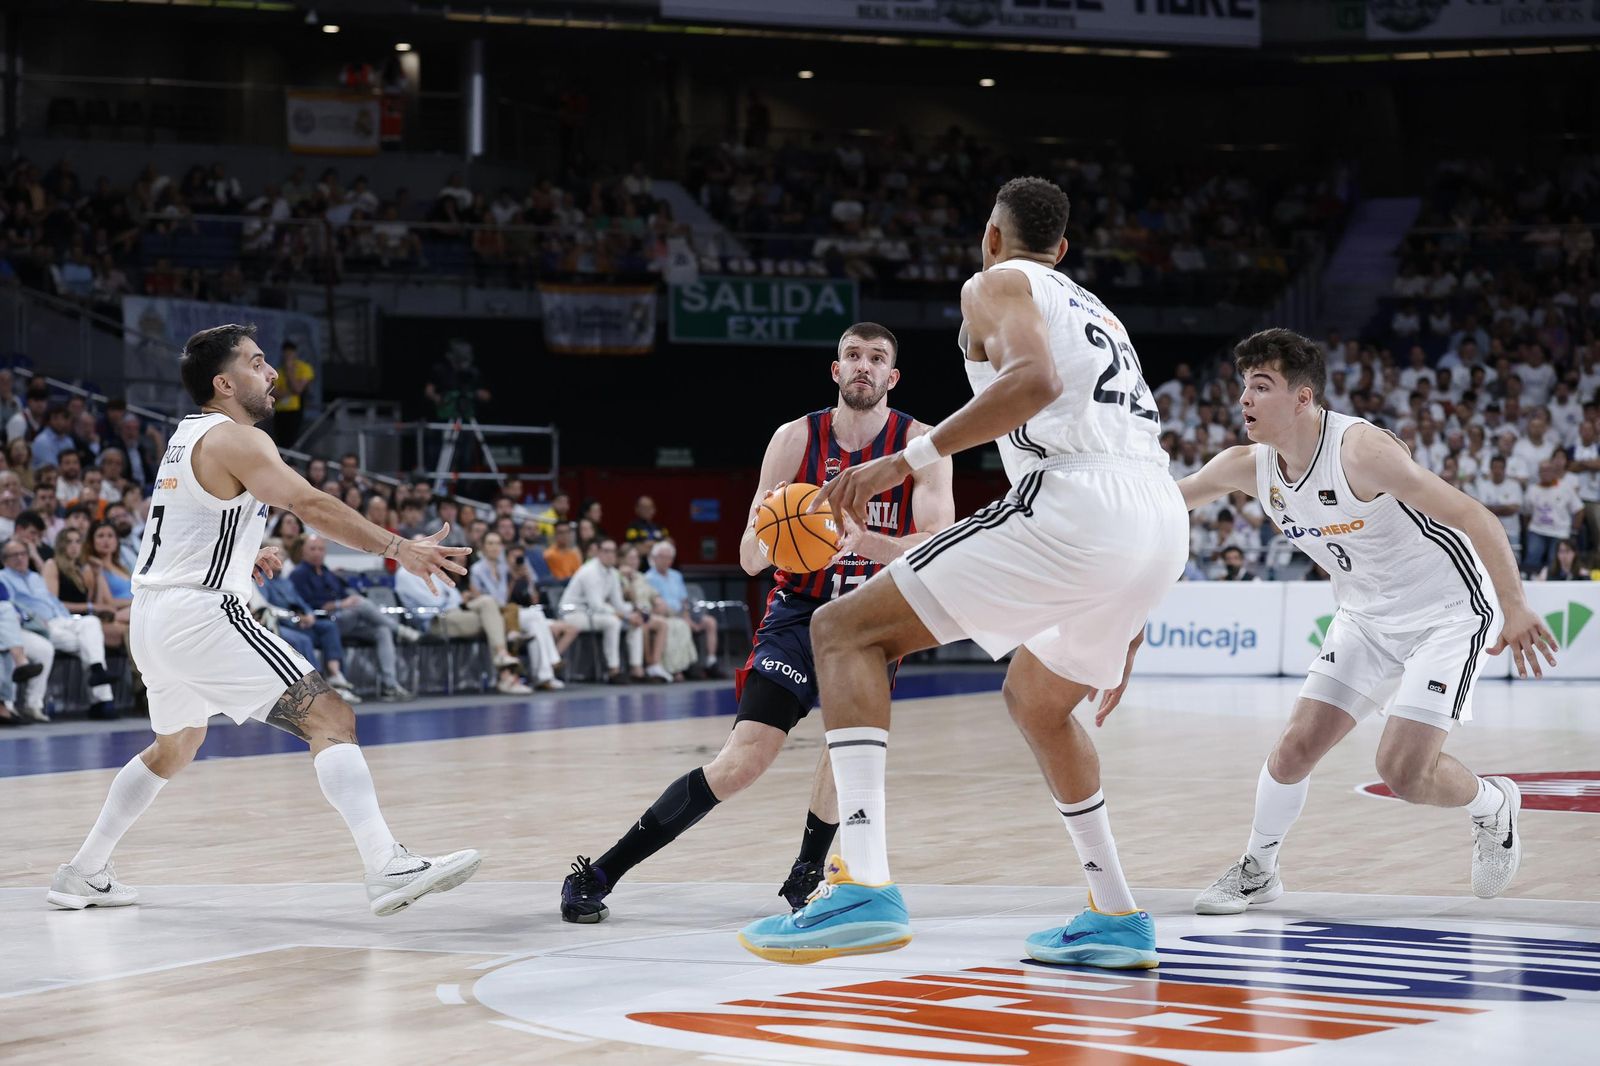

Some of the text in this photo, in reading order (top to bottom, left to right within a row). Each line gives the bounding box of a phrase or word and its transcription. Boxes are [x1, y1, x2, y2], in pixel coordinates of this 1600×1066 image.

[680, 281, 845, 317] SALIDA
[726, 315, 800, 341] EXIT
[1326, 542, 1352, 573] 9
[1146, 622, 1257, 656] Unicaja
